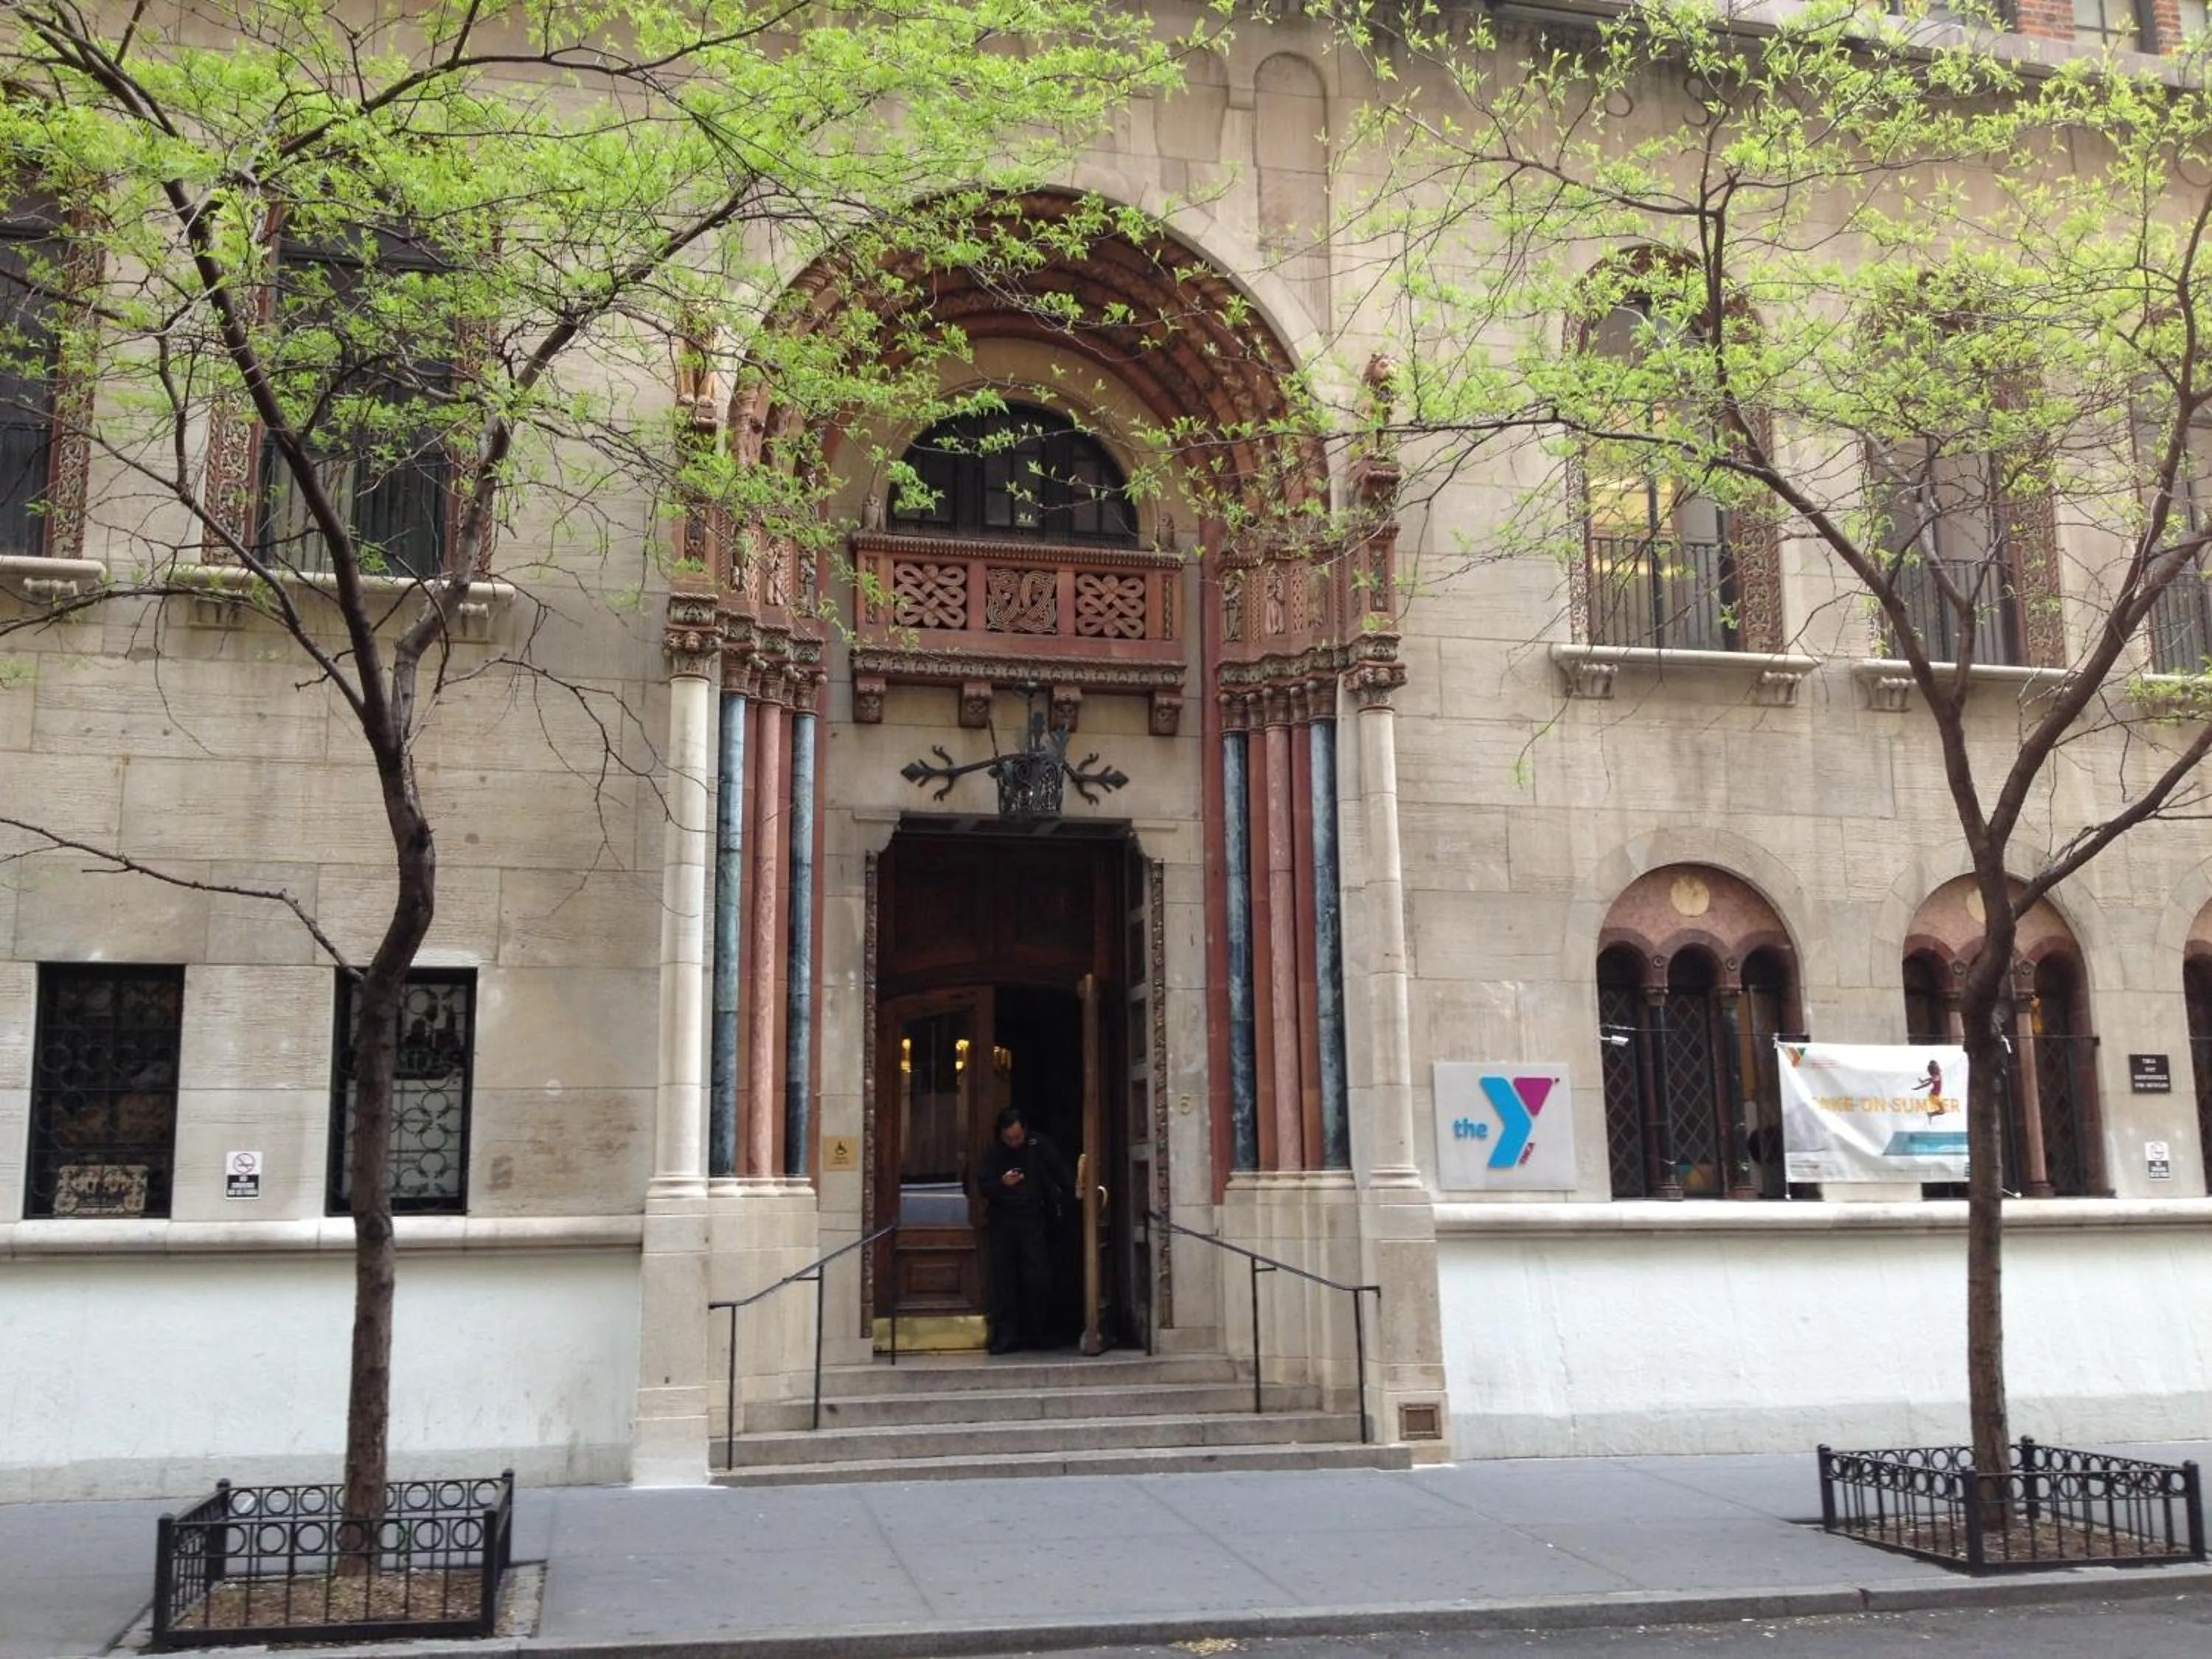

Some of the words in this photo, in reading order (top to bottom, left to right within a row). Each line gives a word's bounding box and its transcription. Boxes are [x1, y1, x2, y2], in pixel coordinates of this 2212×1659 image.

[1860, 1096, 1888, 1113] ON
[1891, 1097, 1961, 1113] SUMER
[1453, 1119, 1488, 1139] the
